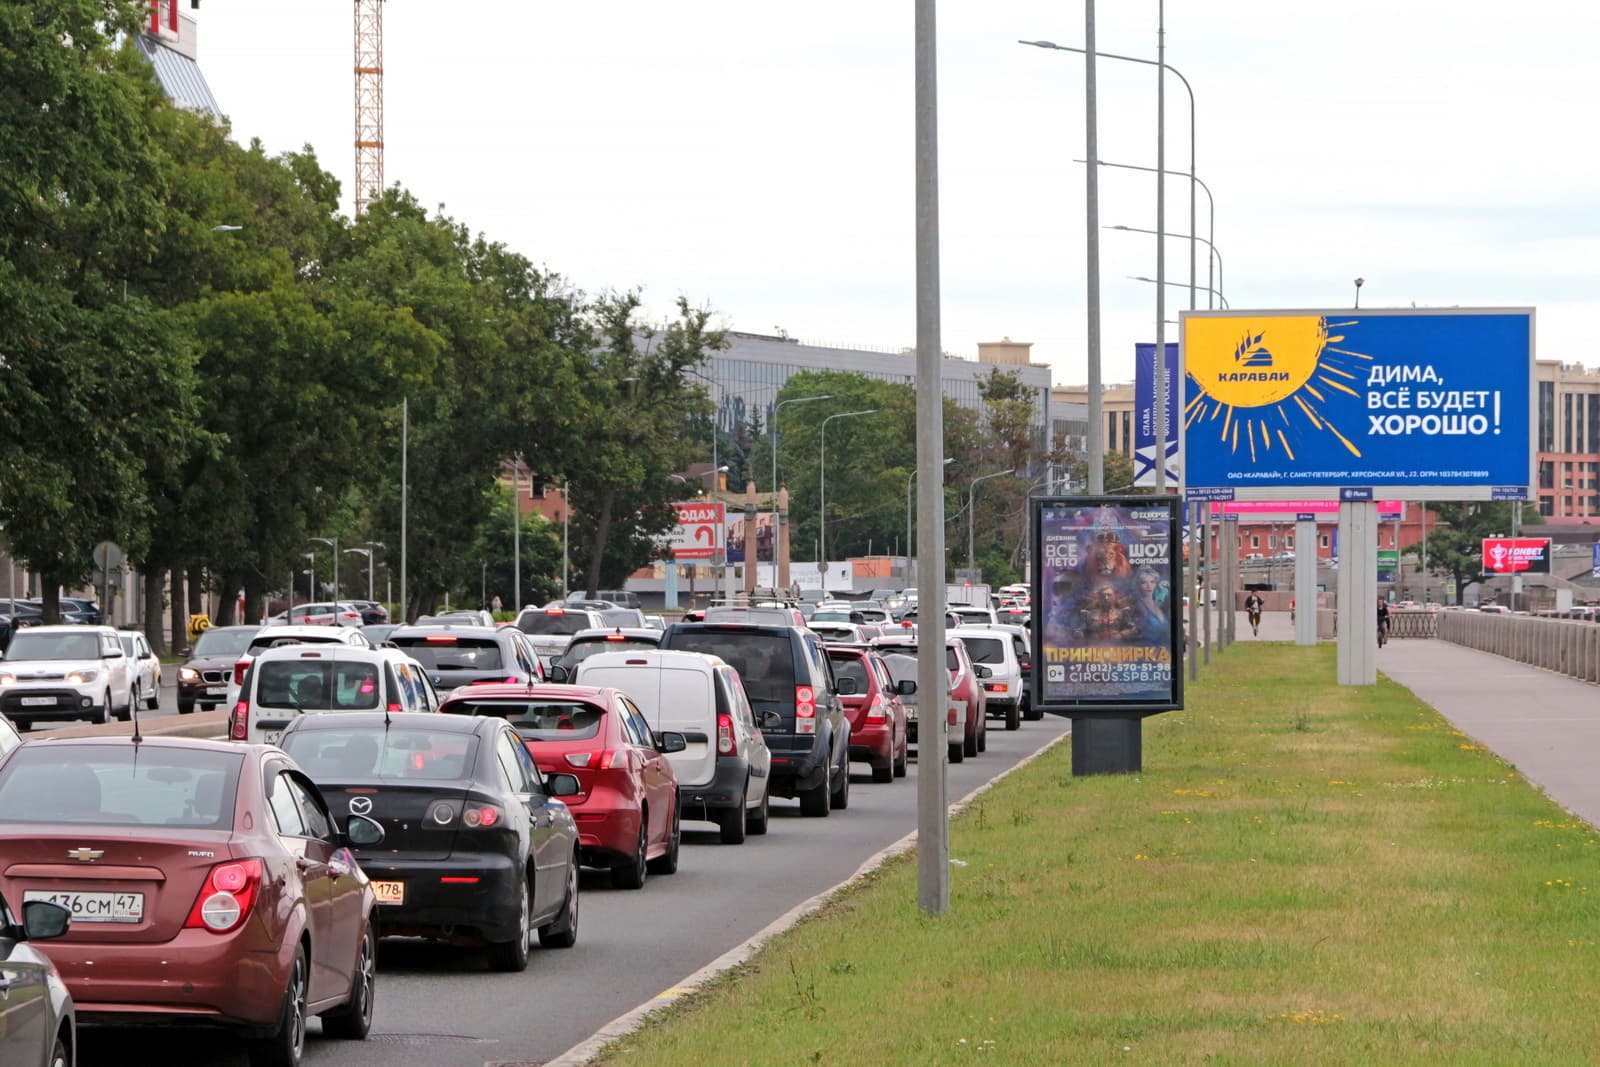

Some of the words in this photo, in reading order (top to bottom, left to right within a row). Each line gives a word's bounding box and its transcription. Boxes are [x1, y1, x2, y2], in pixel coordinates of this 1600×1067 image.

[1367, 365, 1444, 387] ДИМА,
[1367, 387, 1411, 409] ВСЁ
[1417, 391, 1490, 412] БУДЕТ
[1290, 471, 1350, 479] САНКТ-ПЕТЕРБУРГ,
[1128, 543, 1169, 558] ШОУ
[1046, 557, 1078, 567] ЛЕТО
[1045, 647, 1105, 663] ПРИНЦ
[1109, 647, 1171, 662] ЦИРКА
[1049, 669, 1063, 679] 0+
[1069, 663, 1082, 672] +7
[1069, 671, 1171, 682] CIRCUS.SPB.RU
[378, 883, 400, 896] 178
[47, 894, 112, 914] 36СМ
[116, 895, 137, 909] 47
